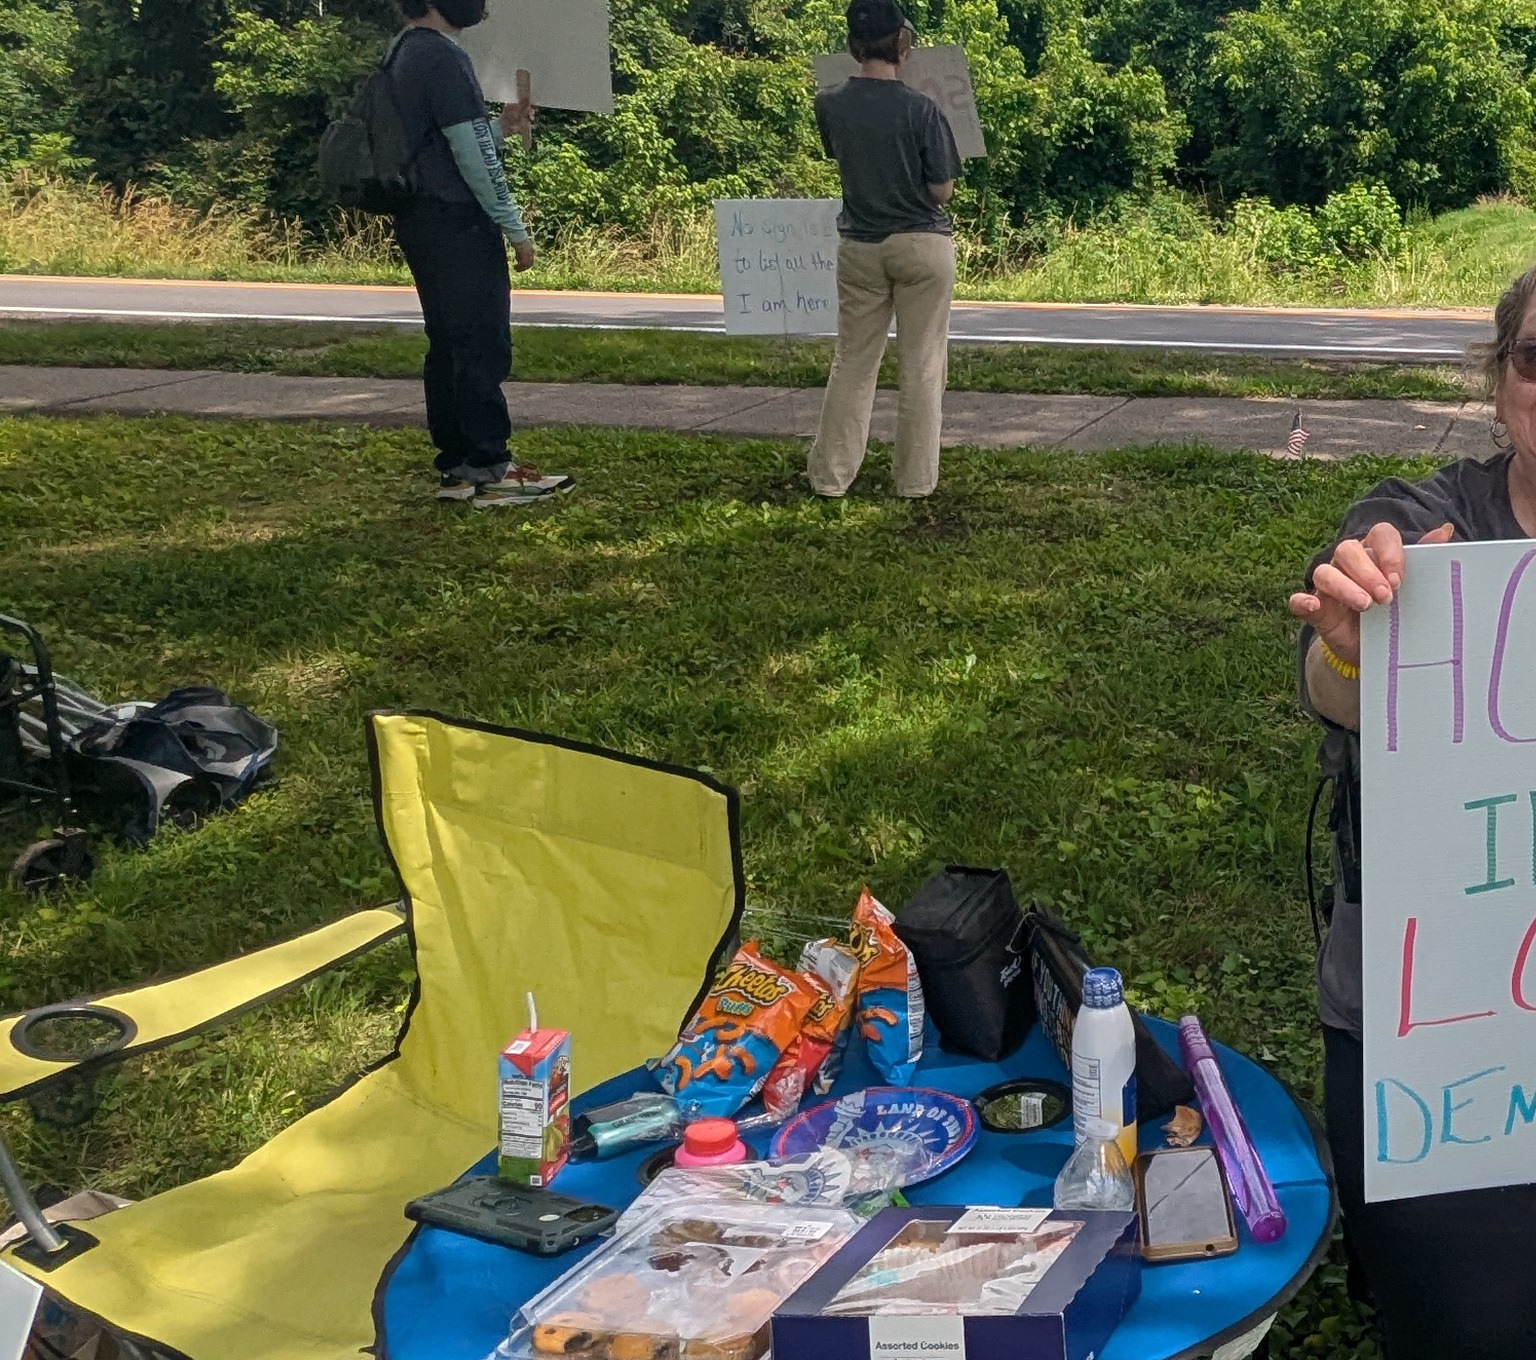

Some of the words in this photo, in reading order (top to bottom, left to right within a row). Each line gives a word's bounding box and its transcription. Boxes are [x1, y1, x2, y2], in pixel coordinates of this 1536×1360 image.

[731, 211, 754, 237] No
[735, 249, 751, 274] to
[758, 249, 780, 272] list
[786, 254, 806, 272] all
[811, 250, 834, 272] the
[737, 293, 753, 315] I
[761, 299, 792, 314] am
[796, 290, 830, 315] here
[877, 1103, 925, 1118] LAND
[926, 1106, 947, 1121] OF
[875, 1341, 918, 1351] Assorted
[920, 1341, 960, 1351] Cookies
